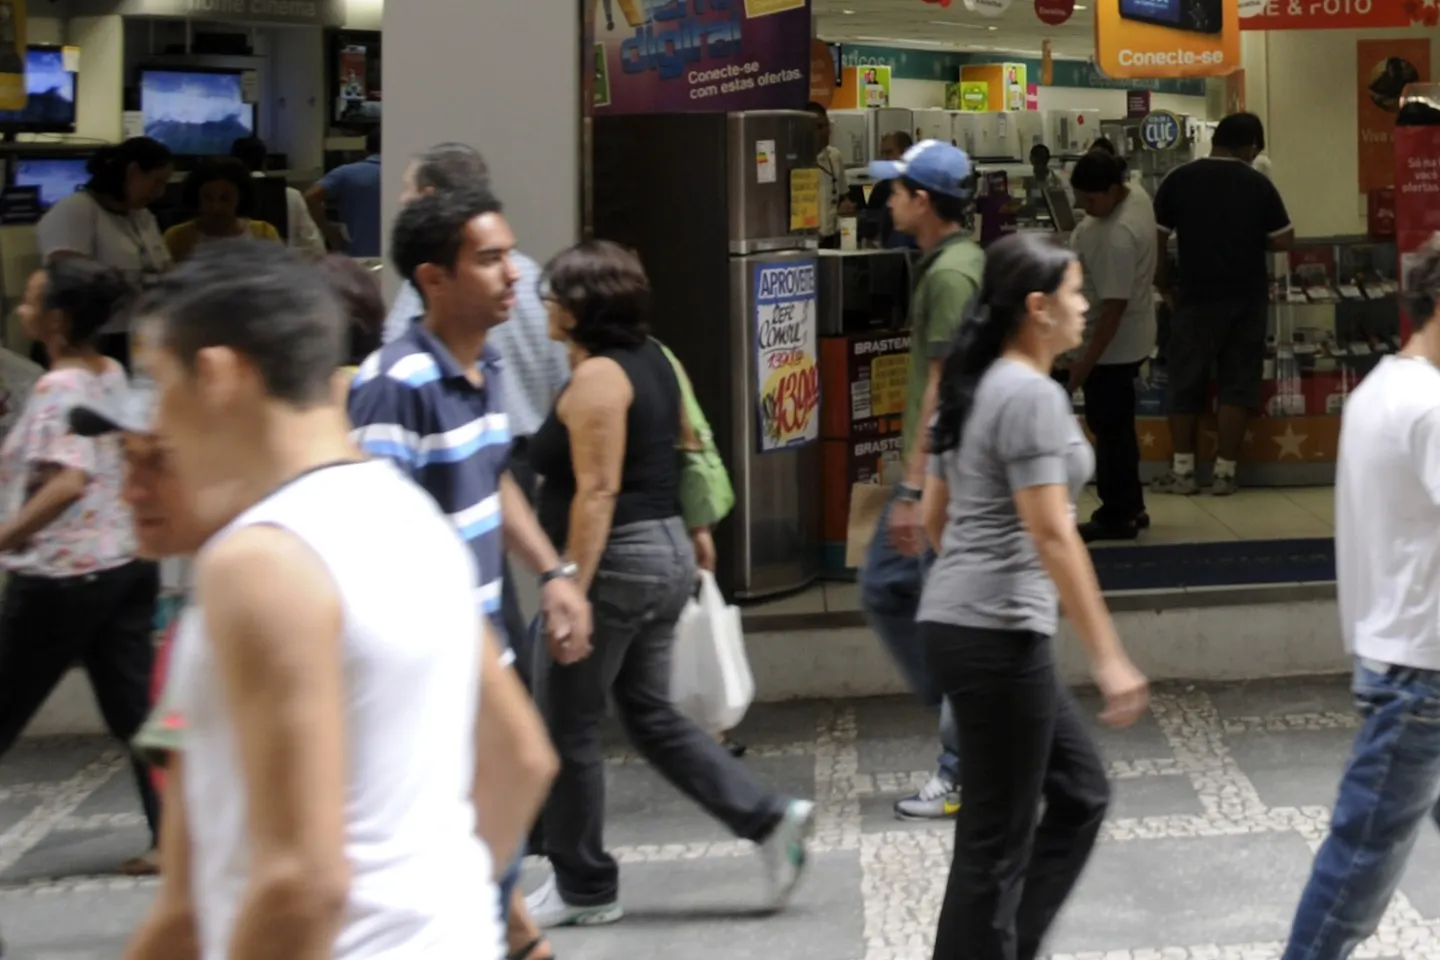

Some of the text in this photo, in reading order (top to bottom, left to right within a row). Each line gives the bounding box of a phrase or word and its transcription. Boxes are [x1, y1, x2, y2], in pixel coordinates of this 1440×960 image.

[620, 10, 743, 81] digital
[1118, 48, 1224, 66] Conecte-se
[687, 60, 760, 85] Conecte-se
[689, 83, 718, 100] com
[720, 76, 756, 94] estas
[1145, 122, 1174, 143] CLIC
[759, 266, 817, 299] APROVEITE
